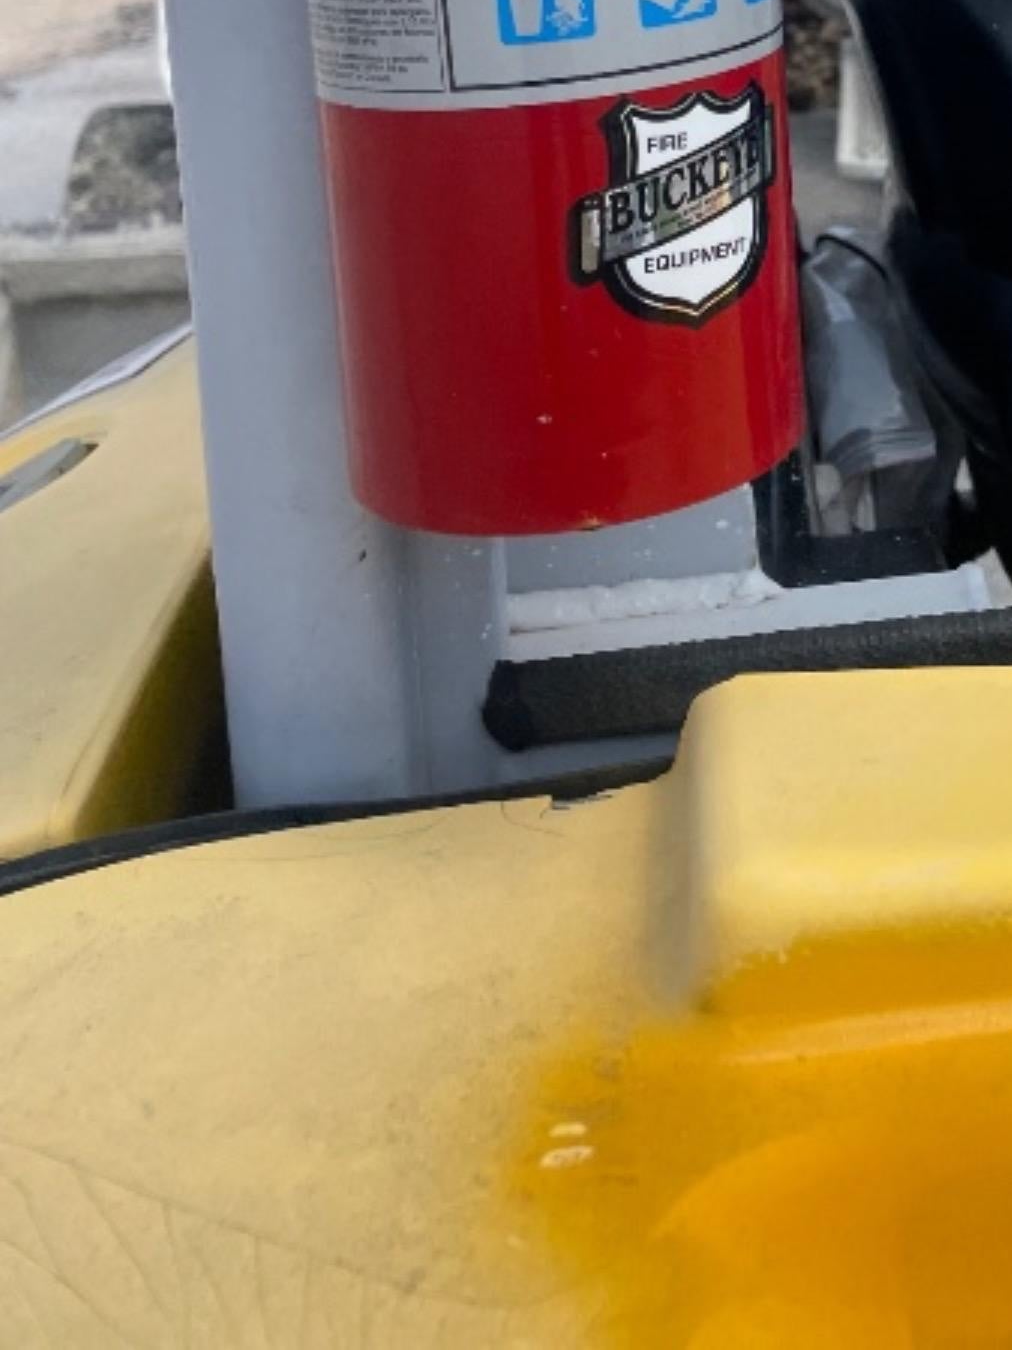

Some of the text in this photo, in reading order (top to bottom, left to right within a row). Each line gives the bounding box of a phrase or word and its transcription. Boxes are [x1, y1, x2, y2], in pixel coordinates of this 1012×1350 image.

[646, 131, 689, 155] FIRE
[607, 128, 762, 236] BUCKEYE
[643, 237, 747, 274] EQUIPMENT
